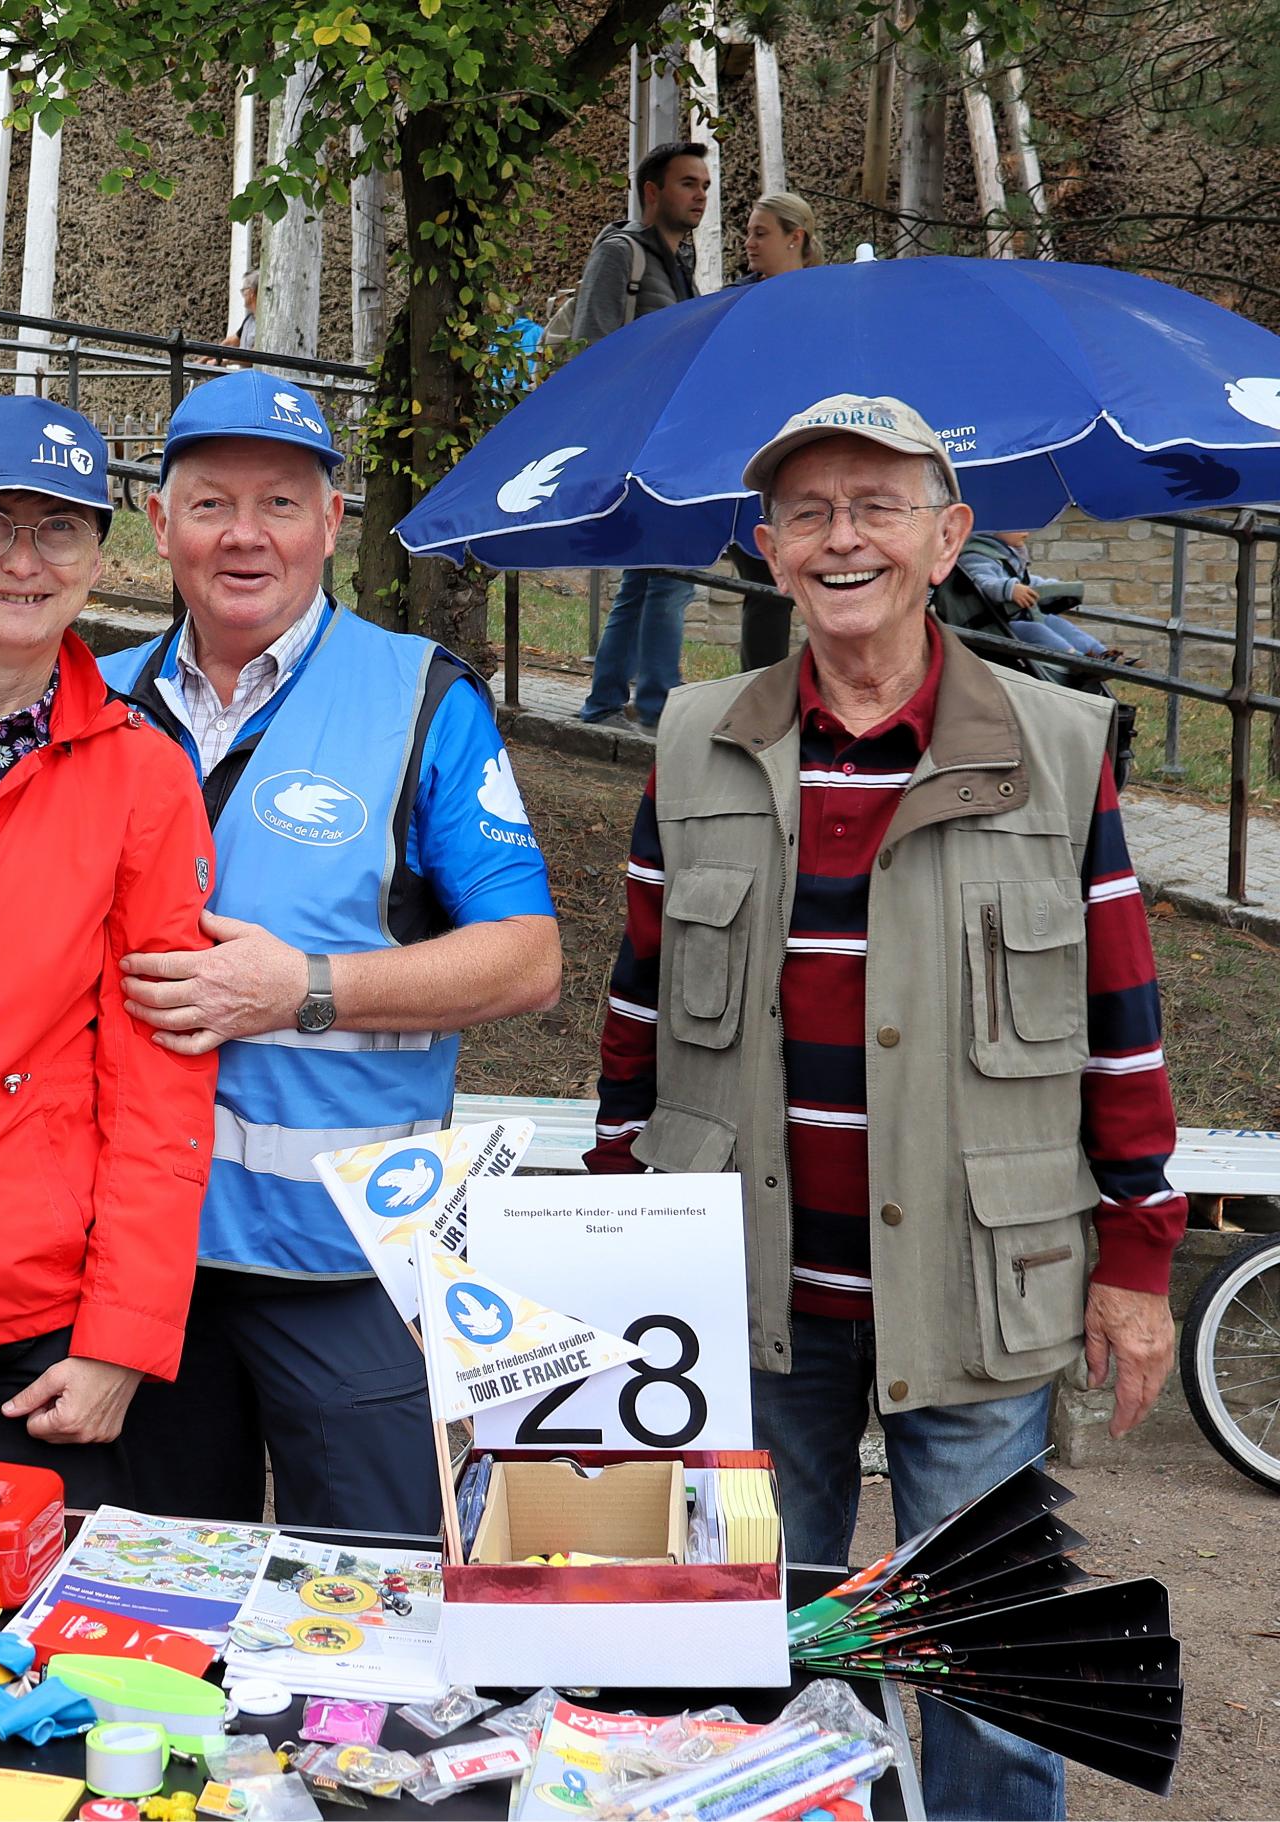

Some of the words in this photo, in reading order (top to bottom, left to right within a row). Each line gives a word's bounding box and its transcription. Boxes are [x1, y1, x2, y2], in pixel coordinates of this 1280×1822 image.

[934, 424, 976, 441] seum
[945, 439, 976, 454] Paix
[264, 809, 293, 831] Course
[294, 823, 308, 837] de
[309, 827, 319, 838] la
[321, 829, 344, 841] Paix
[479, 820, 527, 847] Course
[434, 1216, 449, 1233] der
[483, 1124, 507, 1158] grüßen
[503, 1208, 572, 1219] Stempelkarte
[575, 1207, 615, 1217] Kinder-
[617, 1207, 638, 1217] und
[640, 1206, 707, 1217] Familienfest
[585, 1223, 624, 1234] Station
[455, 1367, 482, 1383] Freunde
[482, 1362, 495, 1376] der
[495, 1343, 558, 1371] Friedensfahrt
[558, 1330, 596, 1353] grüßen
[468, 1379, 500, 1404] TOUR
[500, 1372, 523, 1395] DE
[522, 1349, 592, 1387] FRANCE
[64, 1584, 81, 1594] Kind
[81, 1587, 95, 1596] und
